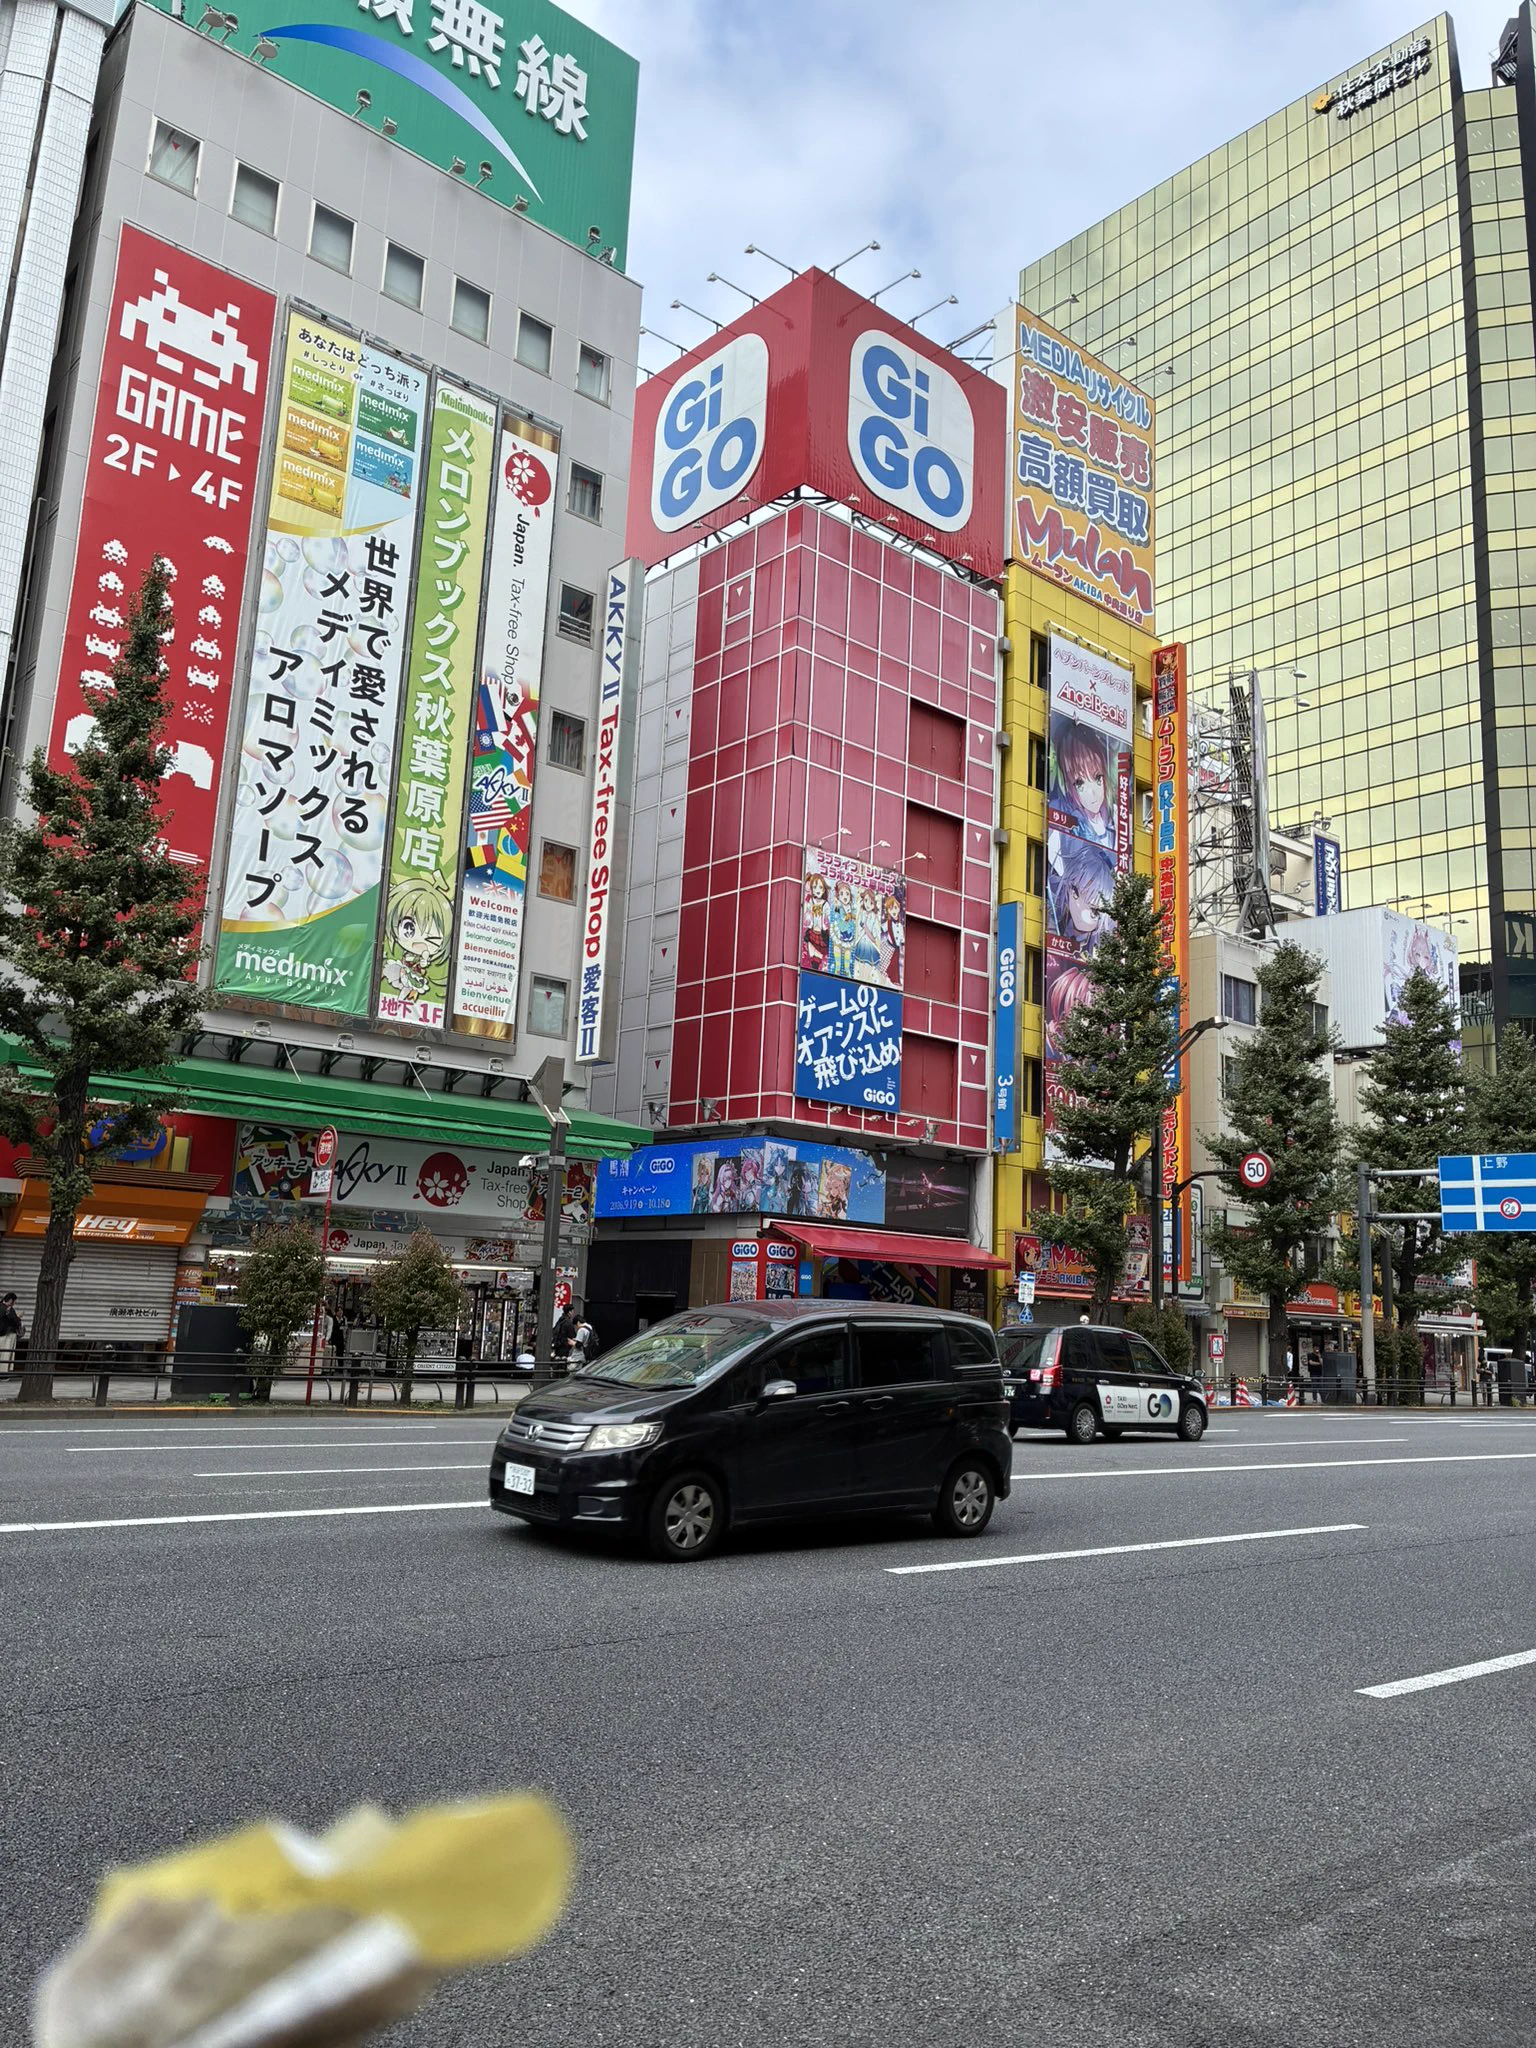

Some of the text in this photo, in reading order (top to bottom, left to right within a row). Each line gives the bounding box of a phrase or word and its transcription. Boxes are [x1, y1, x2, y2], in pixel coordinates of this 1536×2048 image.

[1337, 55, 1429, 116] 秋葉原ビル
[293, 364, 345, 394] medimix
[353, 372, 364, 382] or
[115, 364, 247, 465] GAME
[360, 394, 410, 422] medimix
[440, 390, 495, 427] Melonbooks
[288, 412, 341, 441] medimix
[1020, 365, 1149, 486] 激安販売
[356, 440, 405, 469] medimix
[660, 416, 757, 519] GO
[859, 415, 964, 518] GO
[103, 433, 243, 510] 2F 4F
[283, 459, 336, 488] medimix
[1018, 430, 1149, 541] 高額買取
[1015, 495, 1154, 615] Mulan
[1031, 552, 1074, 584] ムーラン
[1073, 577, 1103, 602] AKIBA
[502, 513, 531, 686] Japan. Tax-free Shop
[604, 575, 627, 674] AKKY
[400, 427, 475, 871] メロンブックス秋葉原店
[335, 535, 400, 834] 世界で愛される
[290, 570, 353, 869] メディミックス
[1158, 717, 1175, 784] ムーラン
[245, 645, 304, 908] アロマソープ
[475, 767, 520, 802] AKKY
[592, 704, 620, 862] Tax-free
[1052, 811, 1067, 825] ゆり
[1157, 780, 1176, 854] AKIBA
[470, 896, 519, 916] Welcome
[583, 864, 610, 959] Shop
[464, 942, 515, 960] Bienvenidos
[466, 931, 516, 948] Selamat datang
[1051, 935, 1072, 948] かなで
[235, 949, 347, 987] medimix
[999, 947, 1015, 1007] GiGO
[245, 971, 336, 997] Ayur Beauty
[461, 987, 511, 1005] Bienvenue
[462, 1001, 506, 1018] accueillir
[799, 984, 878, 1029] ゲームの
[797, 1003, 894, 1066] オアシスに
[863, 1087, 896, 1106] GiGO
[251, 1154, 308, 1172] アッキー2
[651, 1160, 674, 1172] GiGO
[1247, 1162, 1265, 1178] 50
[1482, 1156, 1508, 1169] 上野
[481, 1177, 528, 1195] Tax-free
[621, 1185, 658, 1196] キャンペーン
[496, 1195, 527, 1211] Shop
[77, 1214, 139, 1234] Hey
[733, 1243, 758, 1255] GiGO
[768, 1244, 796, 1258] GiGO
[1058, 1273, 1089, 1285] AKIBA
[1147, 1393, 1173, 1418] GO
